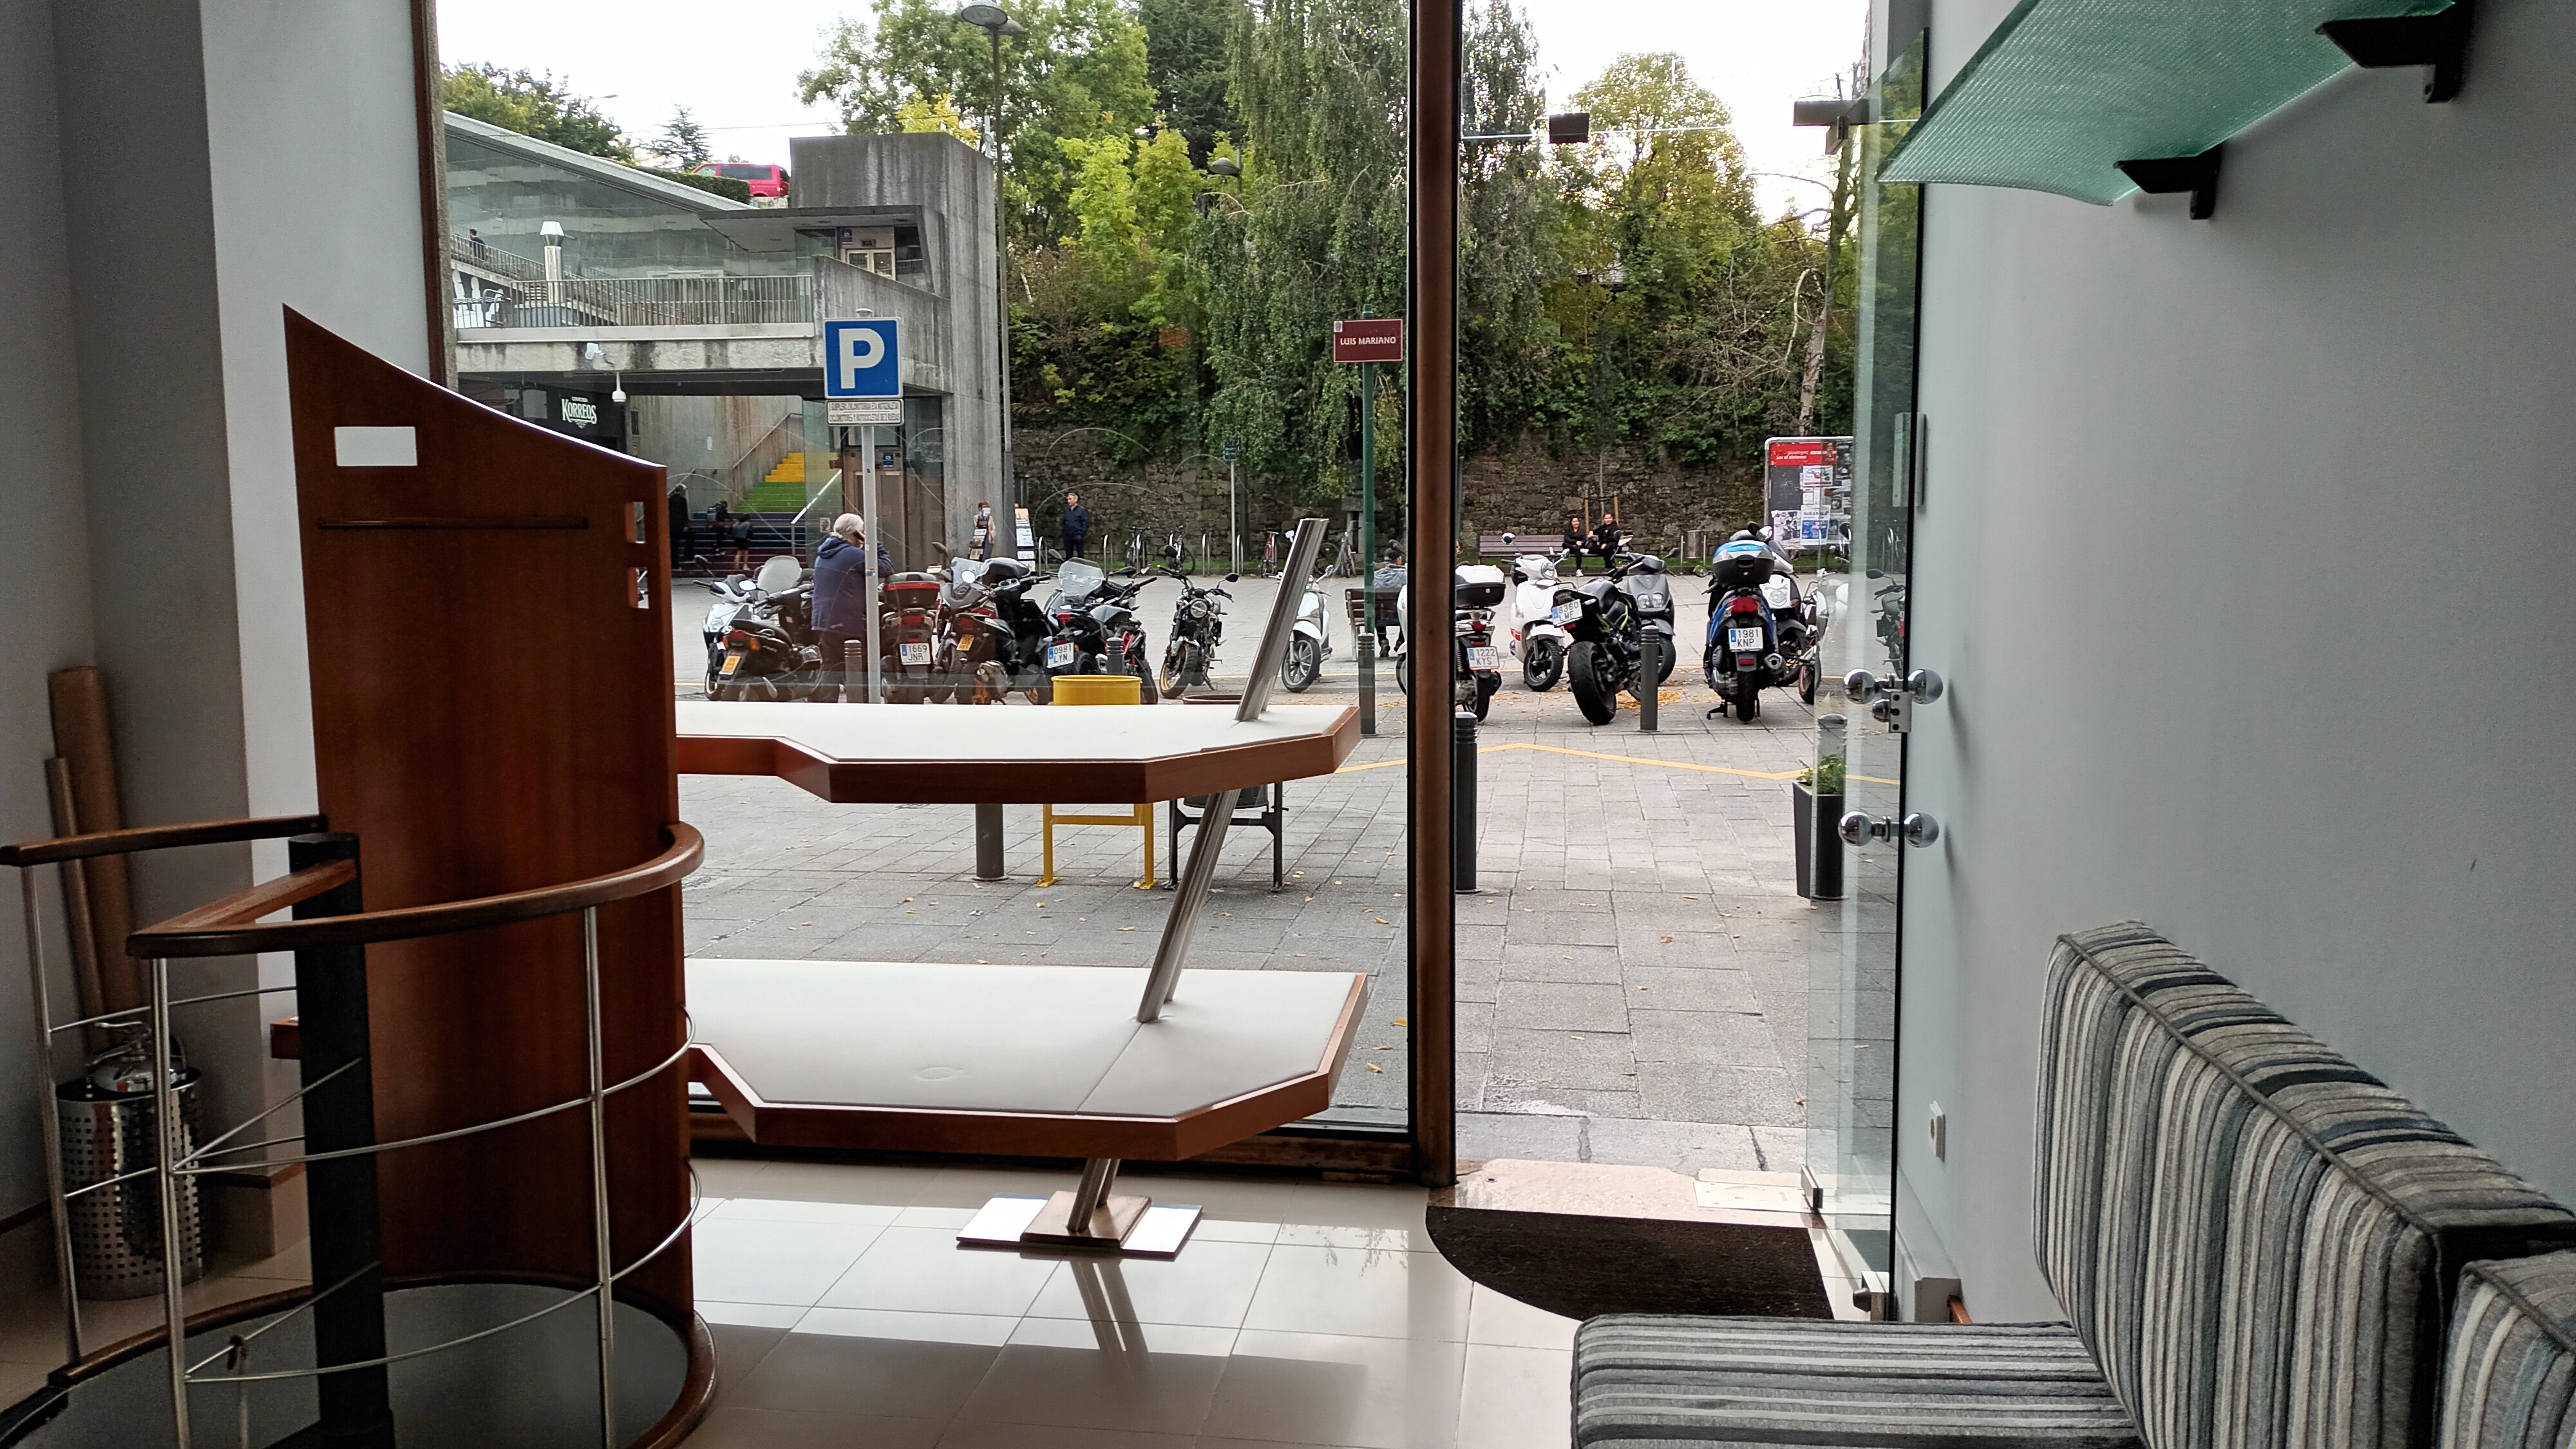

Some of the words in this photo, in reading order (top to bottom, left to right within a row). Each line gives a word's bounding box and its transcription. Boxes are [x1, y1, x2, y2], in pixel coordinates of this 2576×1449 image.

[839, 328, 885, 389] P
[562, 398, 598, 424] KORREOS
[1559, 601, 1578, 614] 8360
[1738, 629, 1758, 638] 1981
[1738, 638, 1754, 647] KNP
[1054, 644, 1072, 655] 0981
[1476, 649, 1495, 657] 1222
[1054, 653, 1068, 663] LYN
[1476, 657, 1492, 665] KYS
